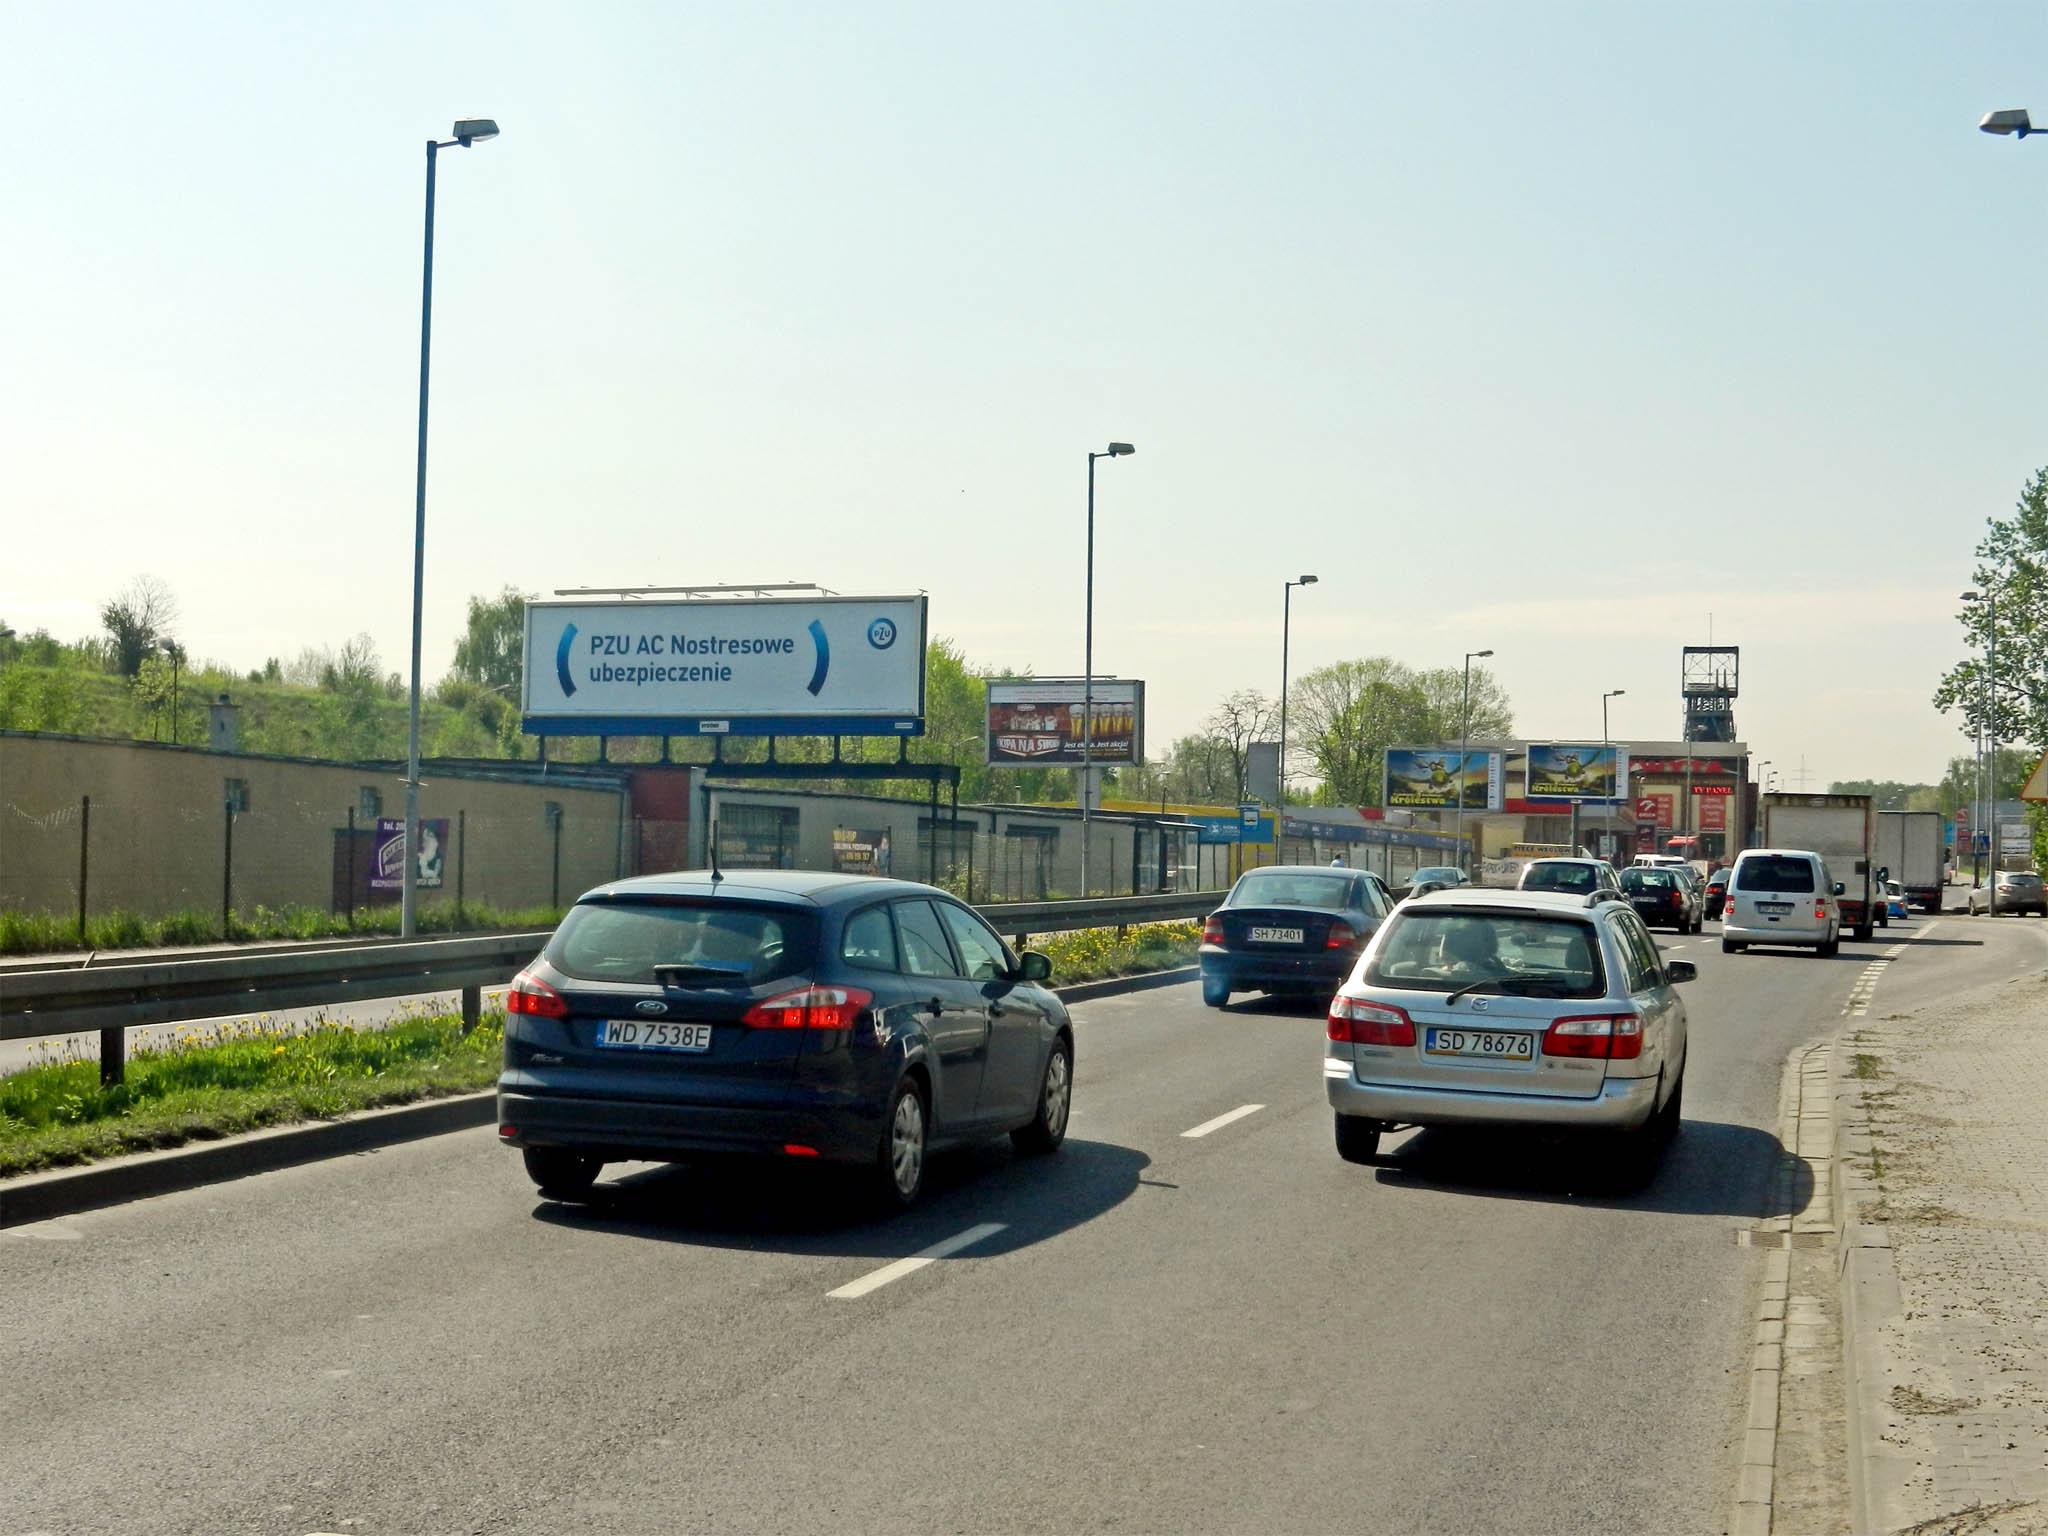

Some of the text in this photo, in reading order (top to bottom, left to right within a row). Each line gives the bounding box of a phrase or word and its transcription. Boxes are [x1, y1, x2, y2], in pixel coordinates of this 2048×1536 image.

[590, 633, 795, 656] PZU AC Nostresowe
[874, 625, 891, 641] PZU
[589, 662, 732, 687] ubezpieczenie
[1252, 927, 1304, 943] SH 73401
[608, 1022, 709, 1047] WD 7538E
[1438, 1032, 1529, 1055] SD 78676
